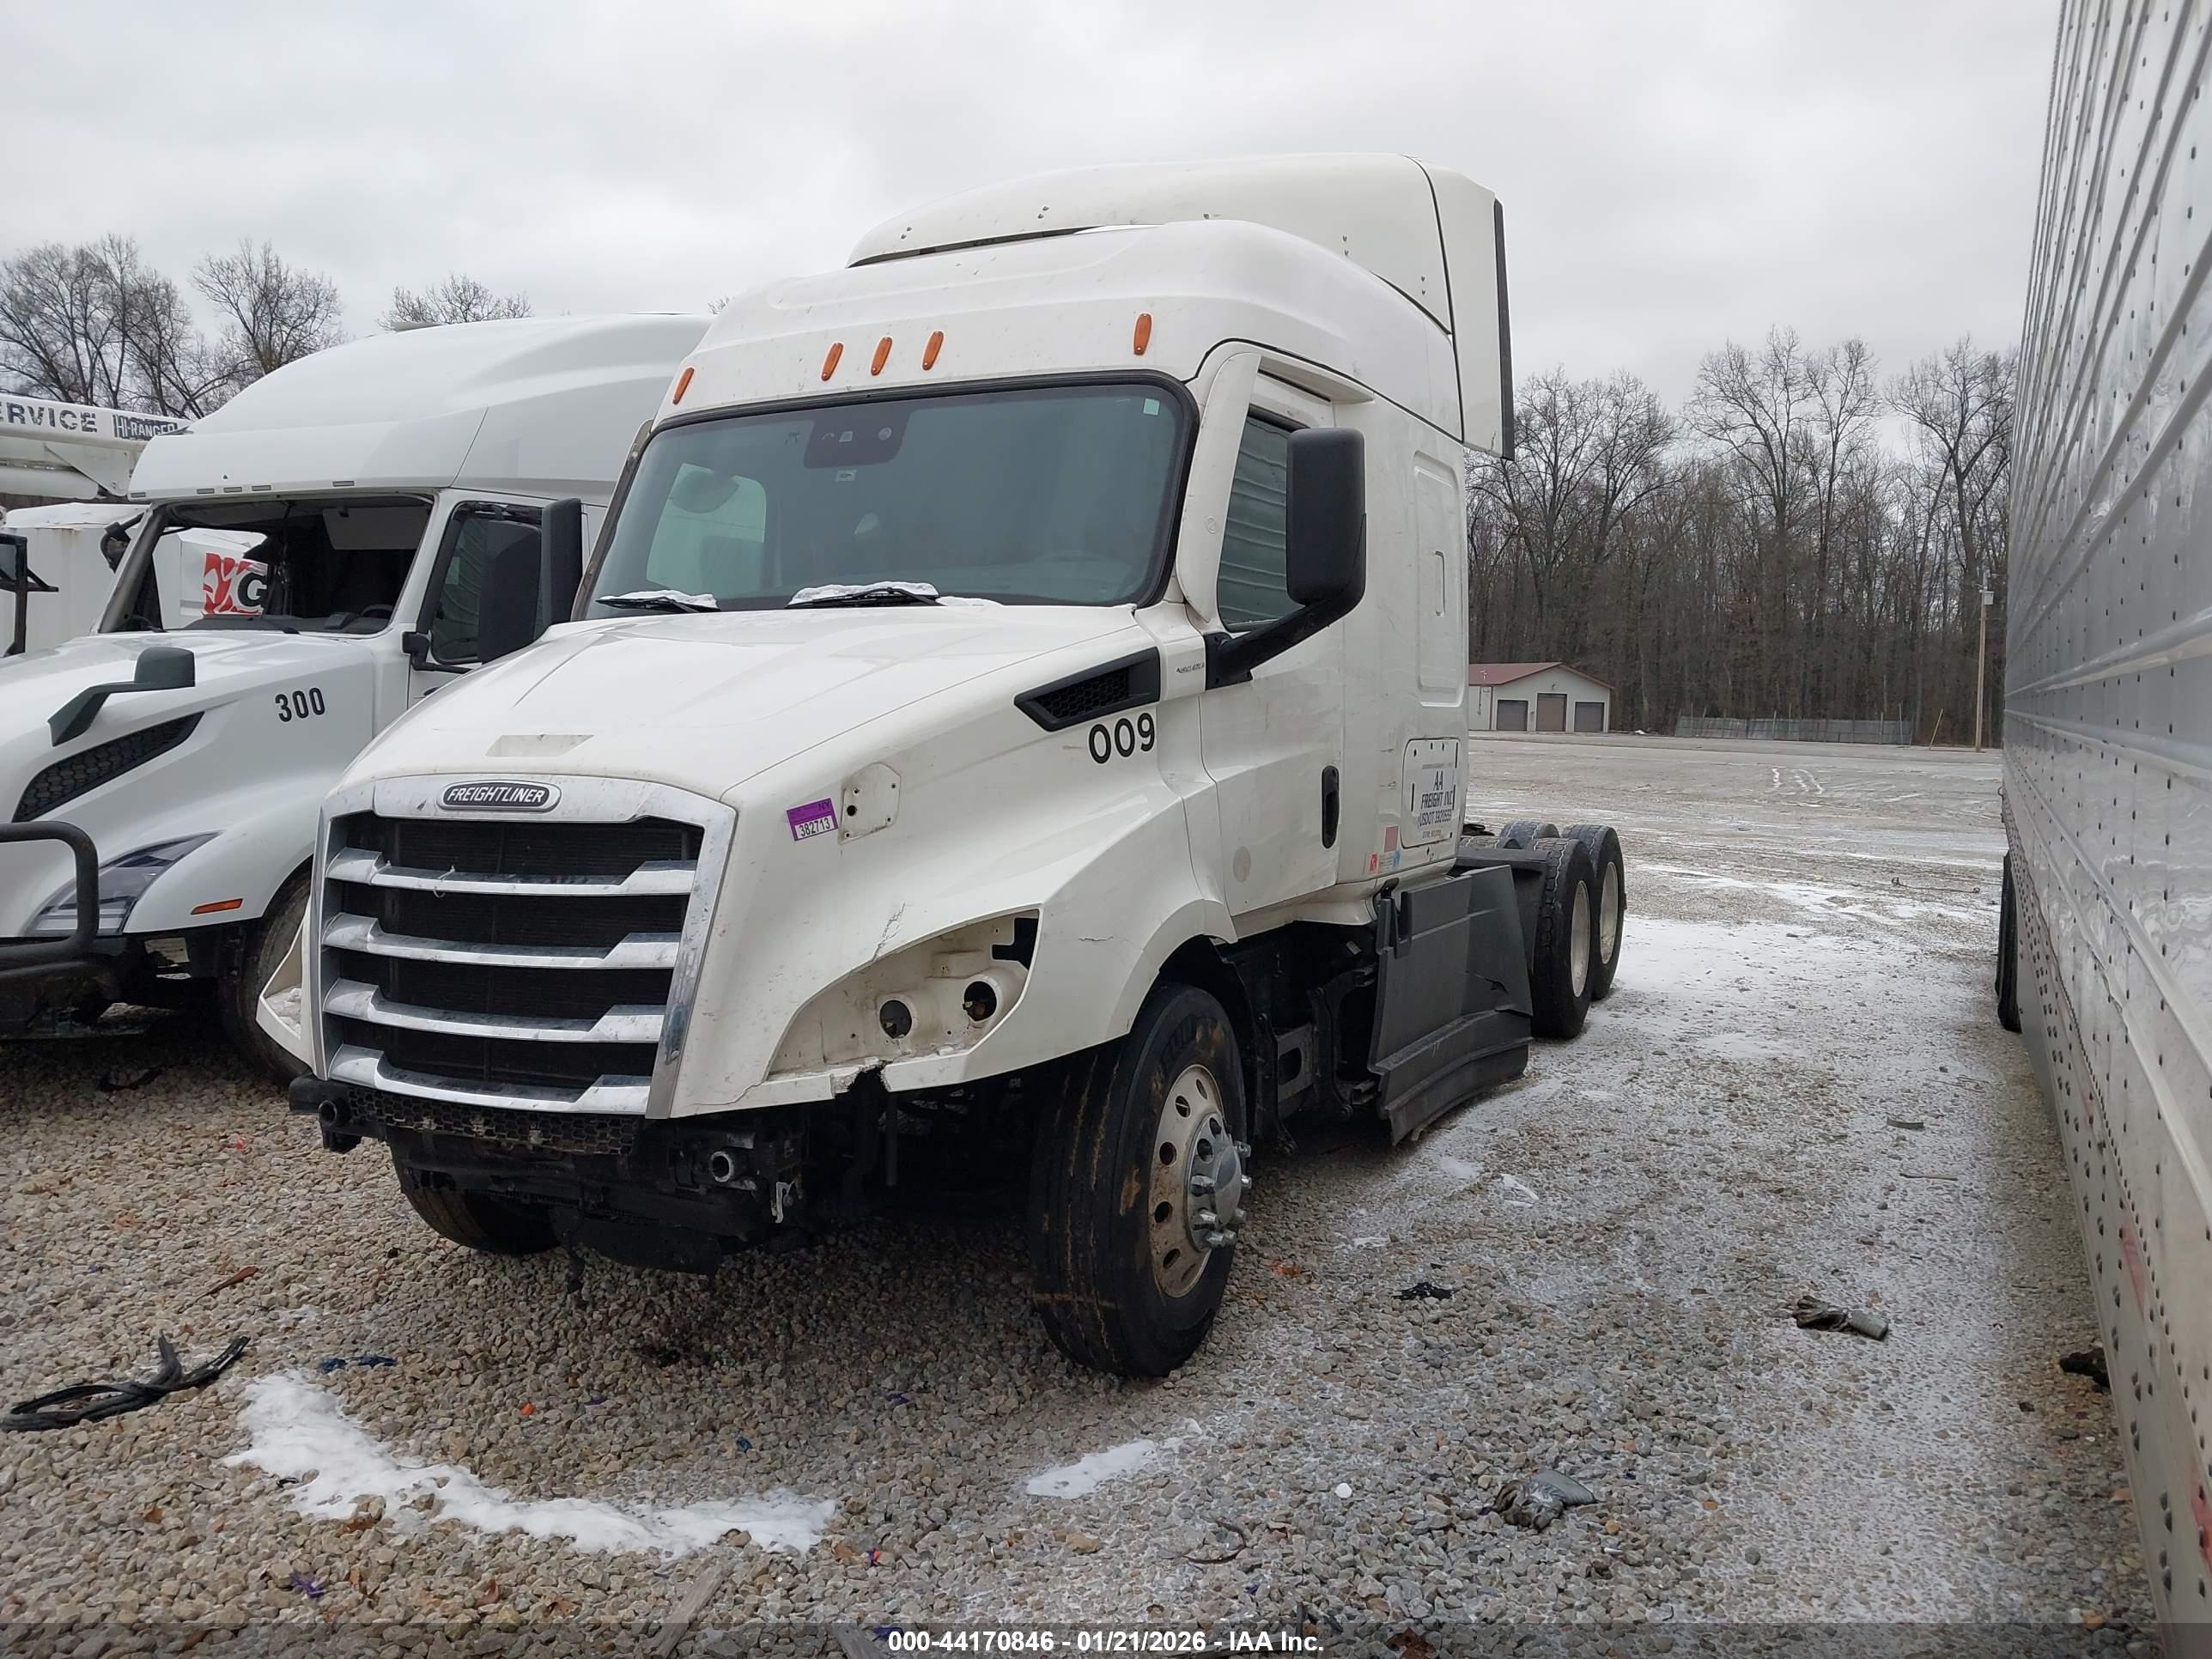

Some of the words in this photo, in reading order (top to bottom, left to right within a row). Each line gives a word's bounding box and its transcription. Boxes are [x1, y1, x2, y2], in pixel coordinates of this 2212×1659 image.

[0, 403, 98, 432] RVICE
[275, 688, 325, 722] 300
[1088, 712, 1155, 764] 009
[446, 786, 546, 803] FREIGHTLINER
[1421, 791, 1443, 809] FREIGHT
[799, 817, 831, 837] 382713
